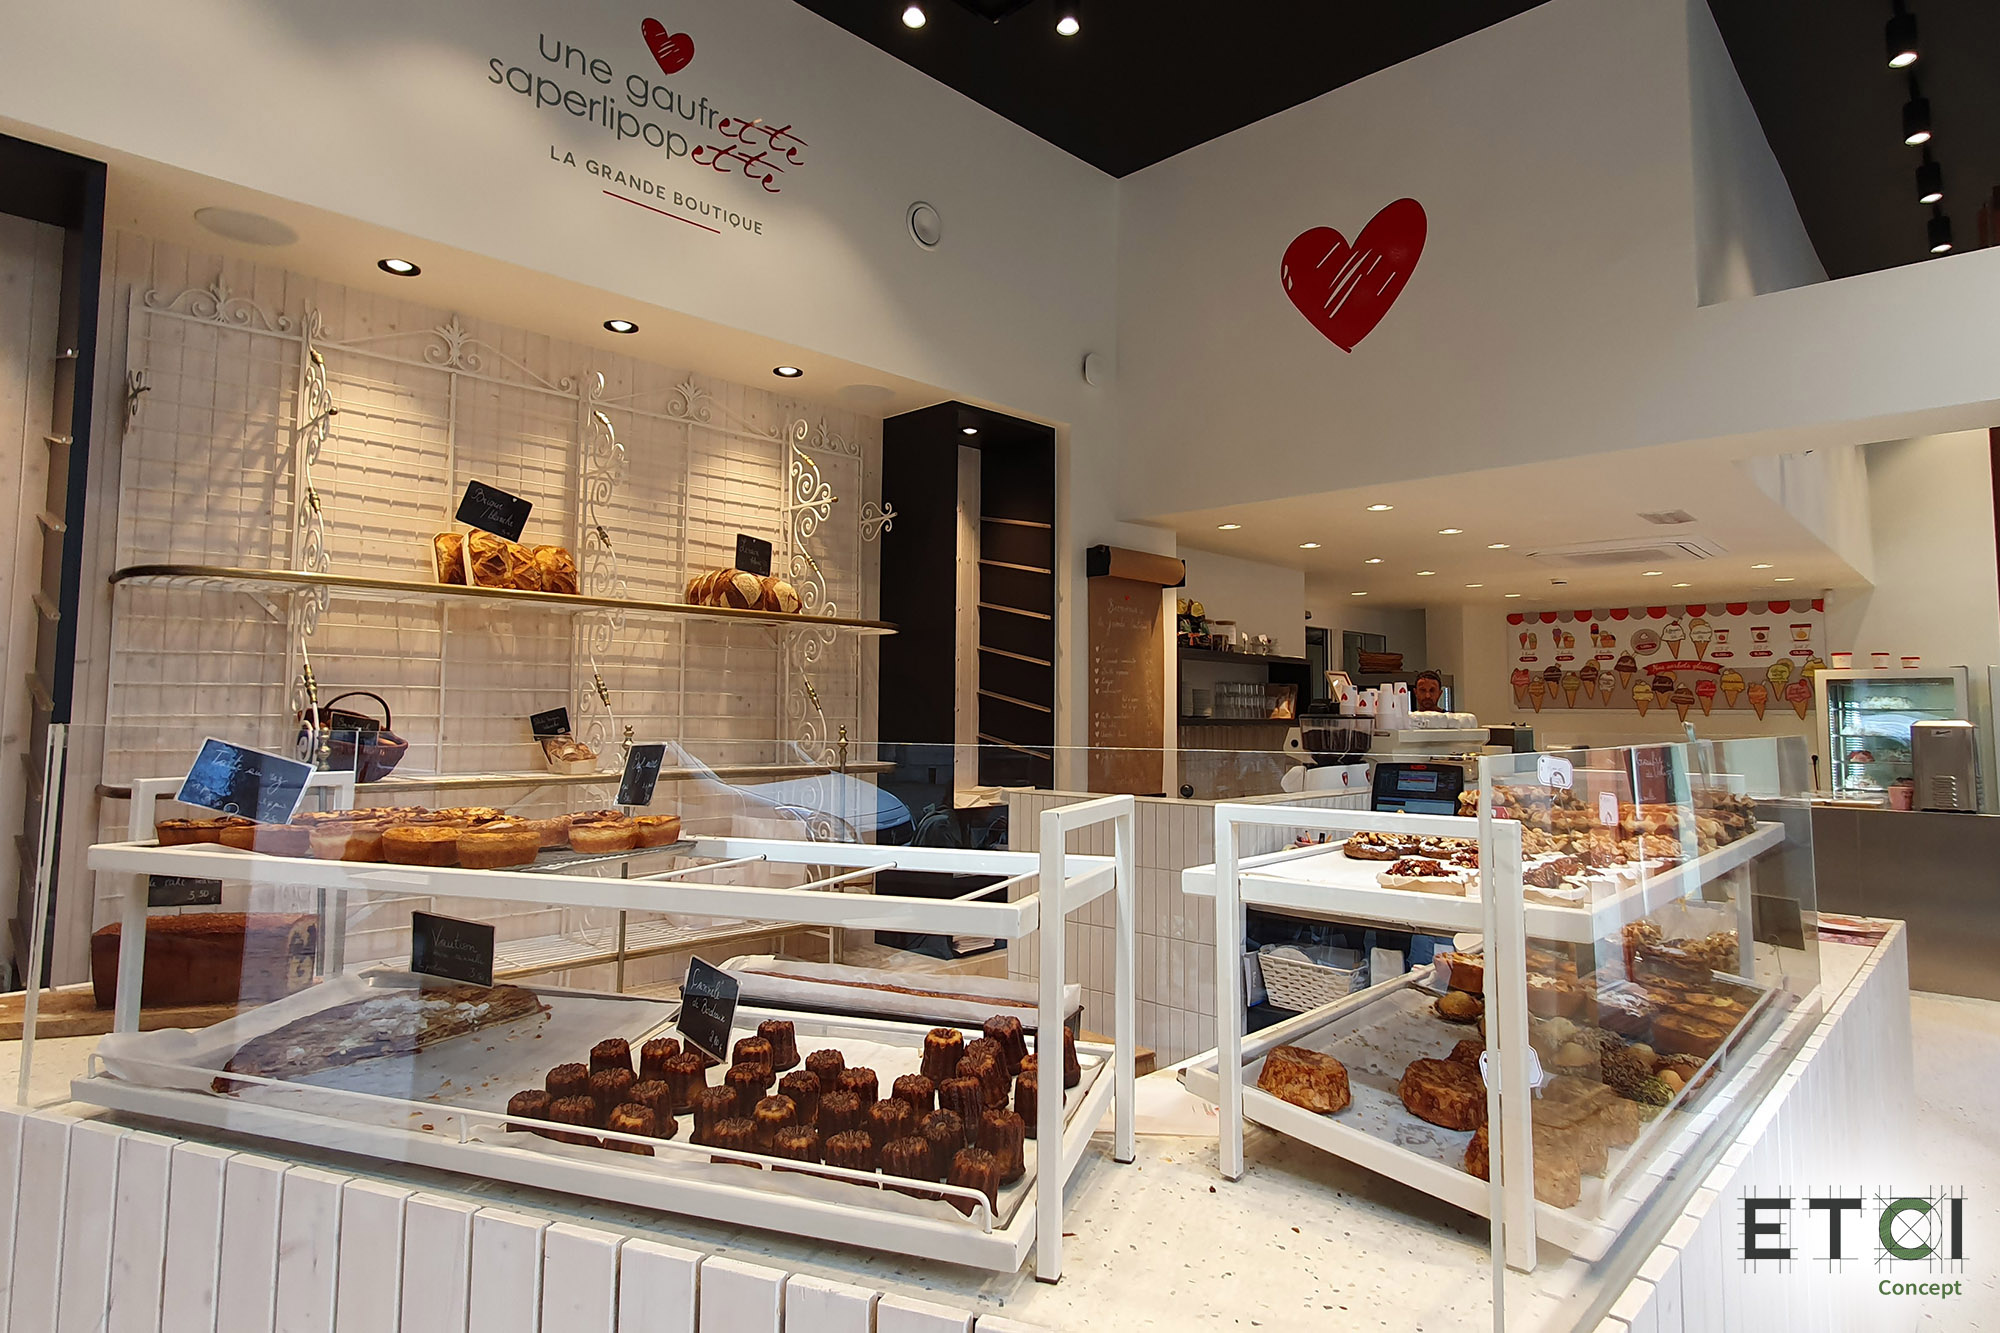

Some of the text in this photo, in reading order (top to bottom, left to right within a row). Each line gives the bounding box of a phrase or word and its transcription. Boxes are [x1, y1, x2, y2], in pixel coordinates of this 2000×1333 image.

[488, 58, 785, 193] saperlipopette
[538, 33, 808, 166] une gaufrette
[550, 145, 764, 236] LA GRANDE BOUTIQUE
[211, 749, 244, 771] Tarte
